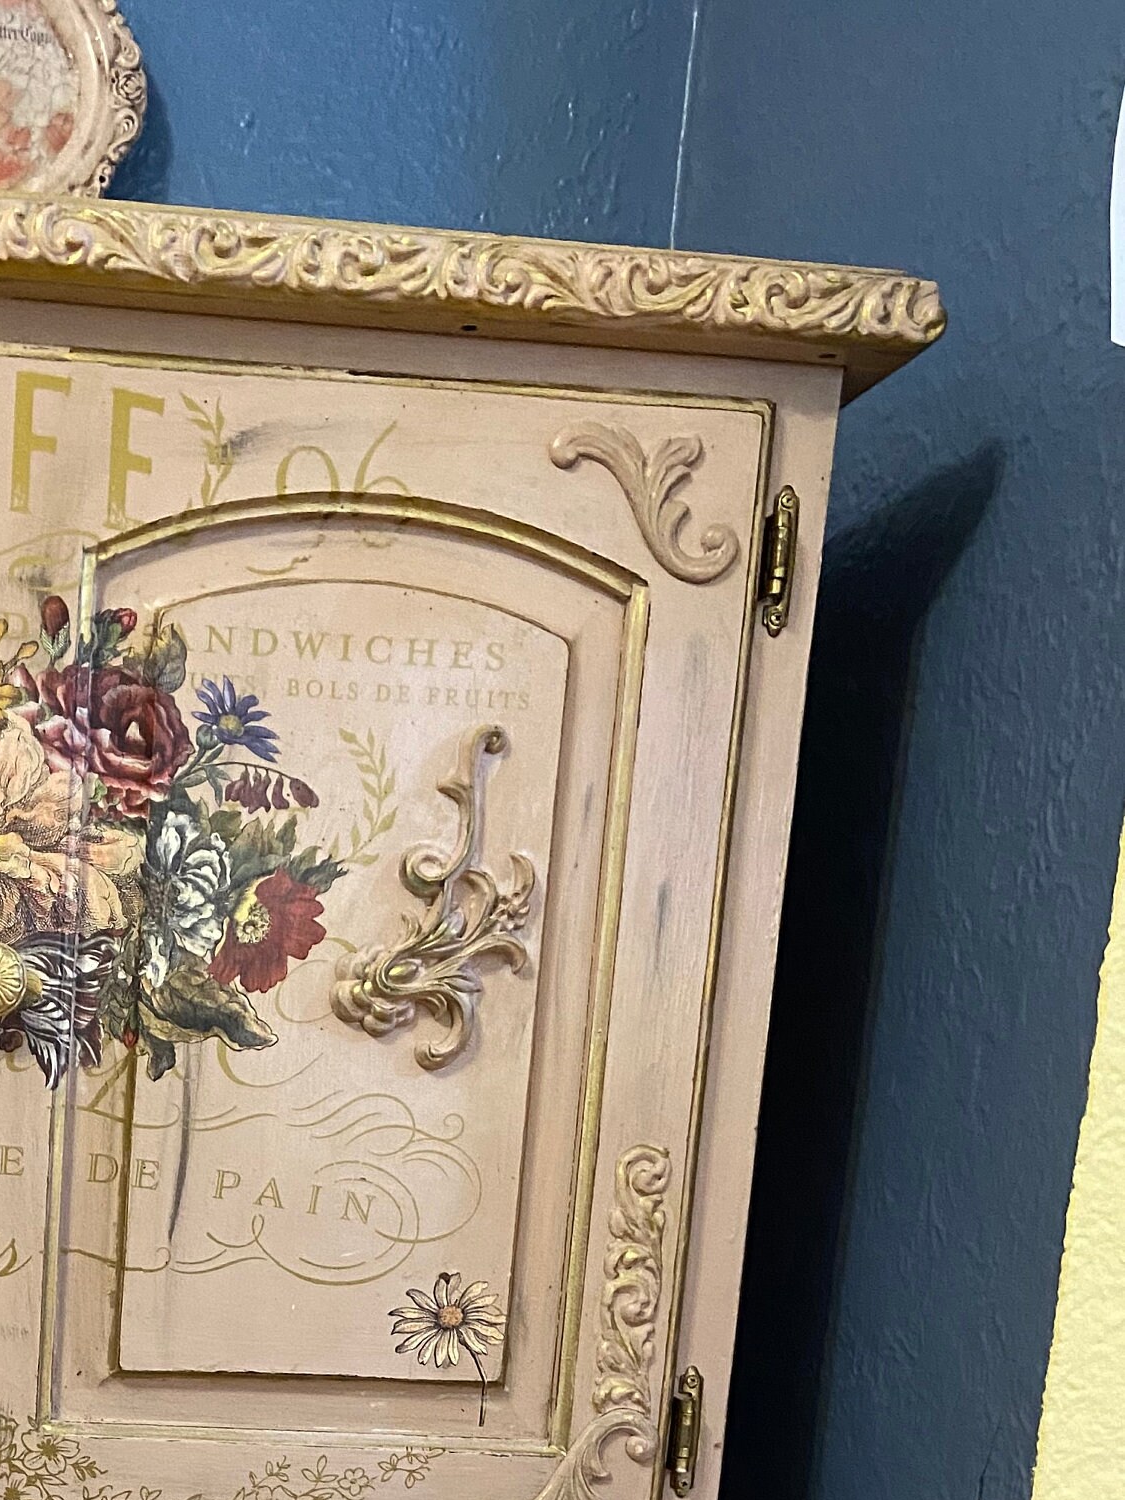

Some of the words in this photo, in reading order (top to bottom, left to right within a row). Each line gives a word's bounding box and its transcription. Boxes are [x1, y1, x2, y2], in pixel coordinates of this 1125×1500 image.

[286, 678, 359, 701] BOLS
[376, 684, 411, 704] DE
[426, 686, 531, 711] FRUITS
[86, 1152, 160, 1191] DE
[214, 1169, 376, 1226] PAIN
